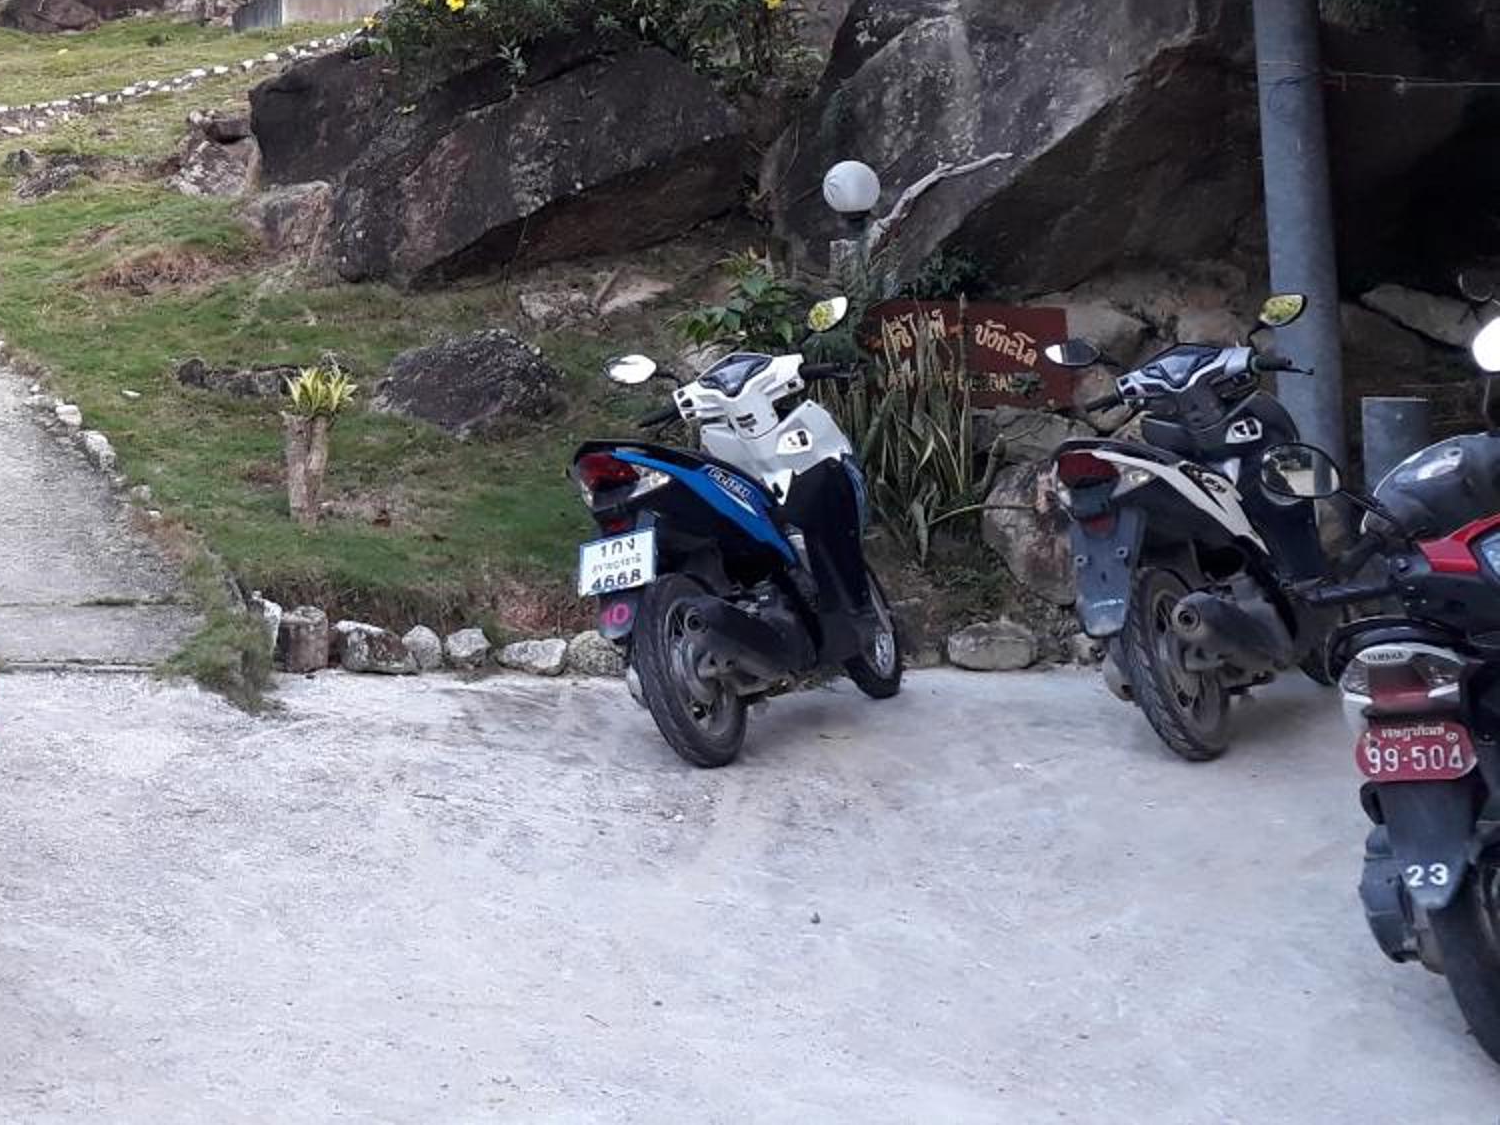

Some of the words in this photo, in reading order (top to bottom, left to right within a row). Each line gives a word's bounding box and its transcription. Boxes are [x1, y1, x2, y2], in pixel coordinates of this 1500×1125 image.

[974, 318, 1038, 367] บังกะโล
[590, 568, 641, 591] 4668
[1405, 863, 1449, 888] 23
